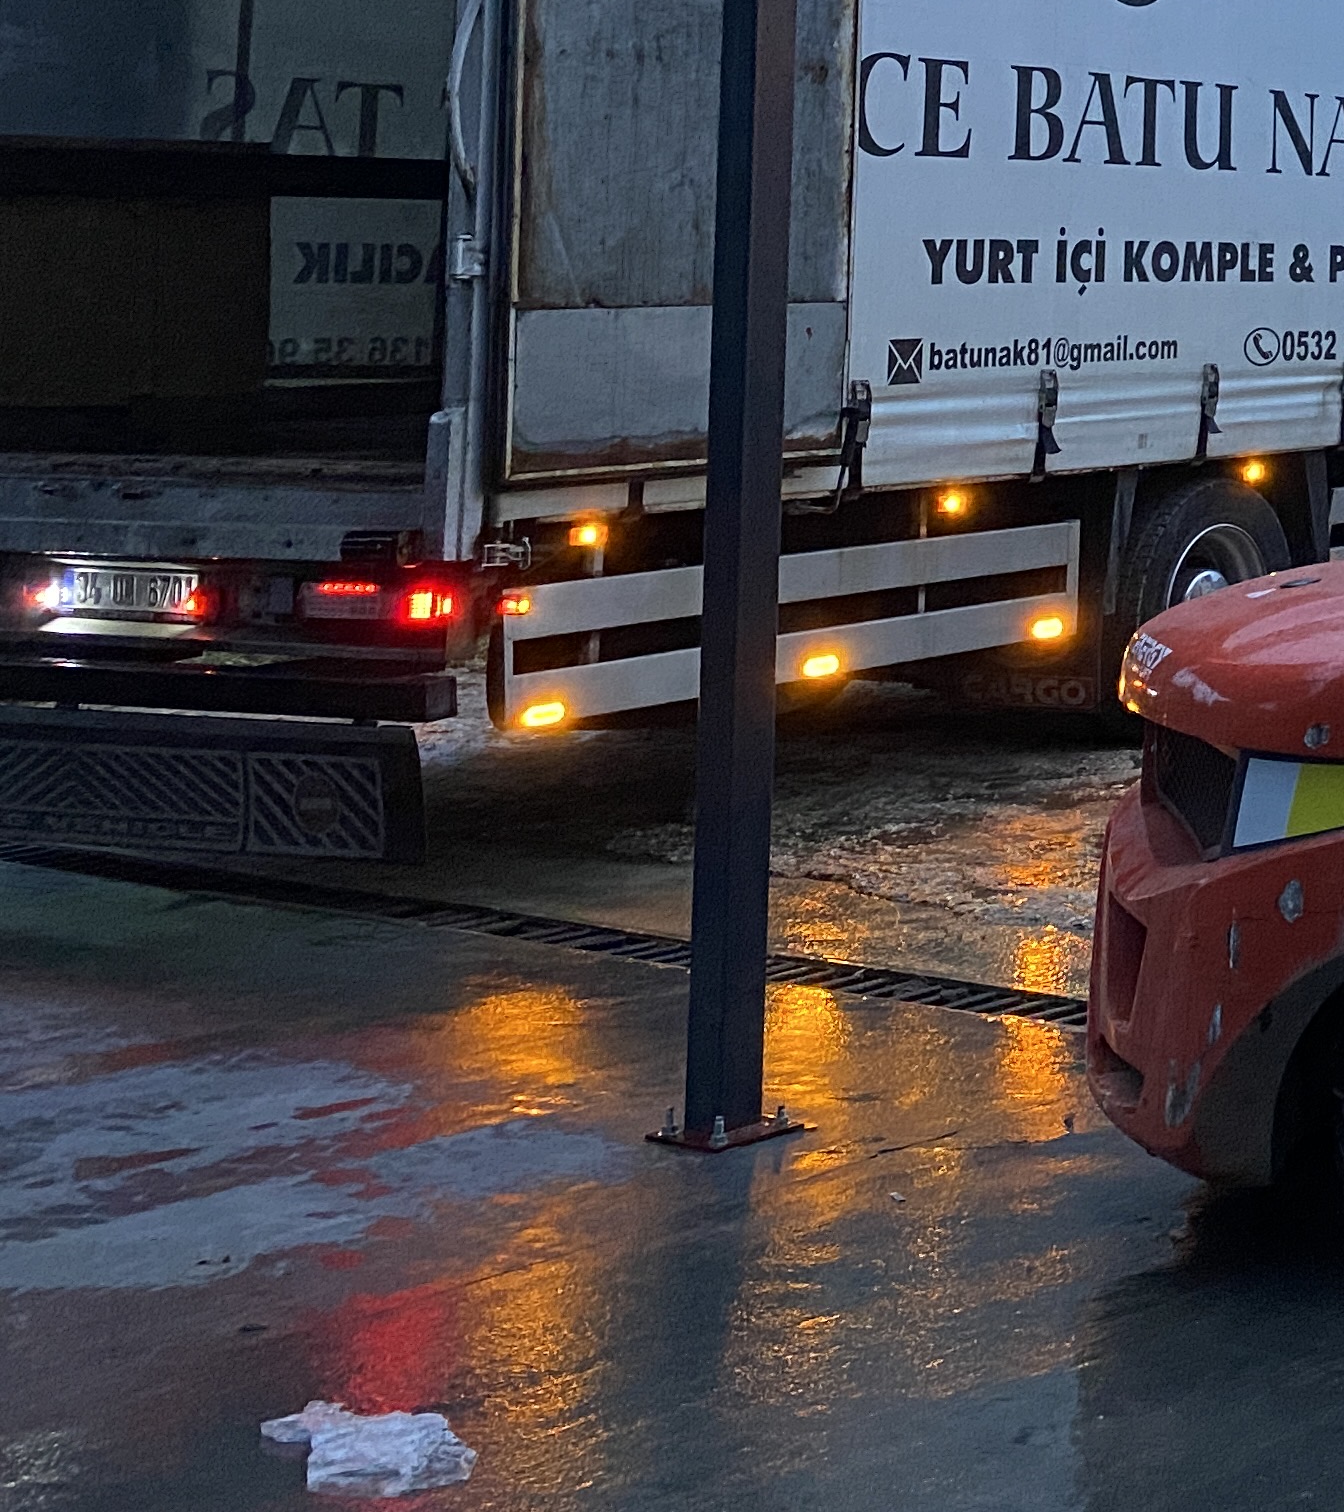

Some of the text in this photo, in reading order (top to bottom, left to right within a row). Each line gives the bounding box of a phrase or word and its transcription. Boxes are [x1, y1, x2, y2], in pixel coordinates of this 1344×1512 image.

[1007, 64, 1240, 171] BATU
[922, 238, 1039, 285] YURT
[1055, 226, 1106, 296] İÇİ
[1123, 240, 1275, 282] KOMPLE
[1289, 243, 1315, 283] &
[928, 335, 1179, 371] batunak81@gmail.com
[1282, 330, 1337, 361] 0532
